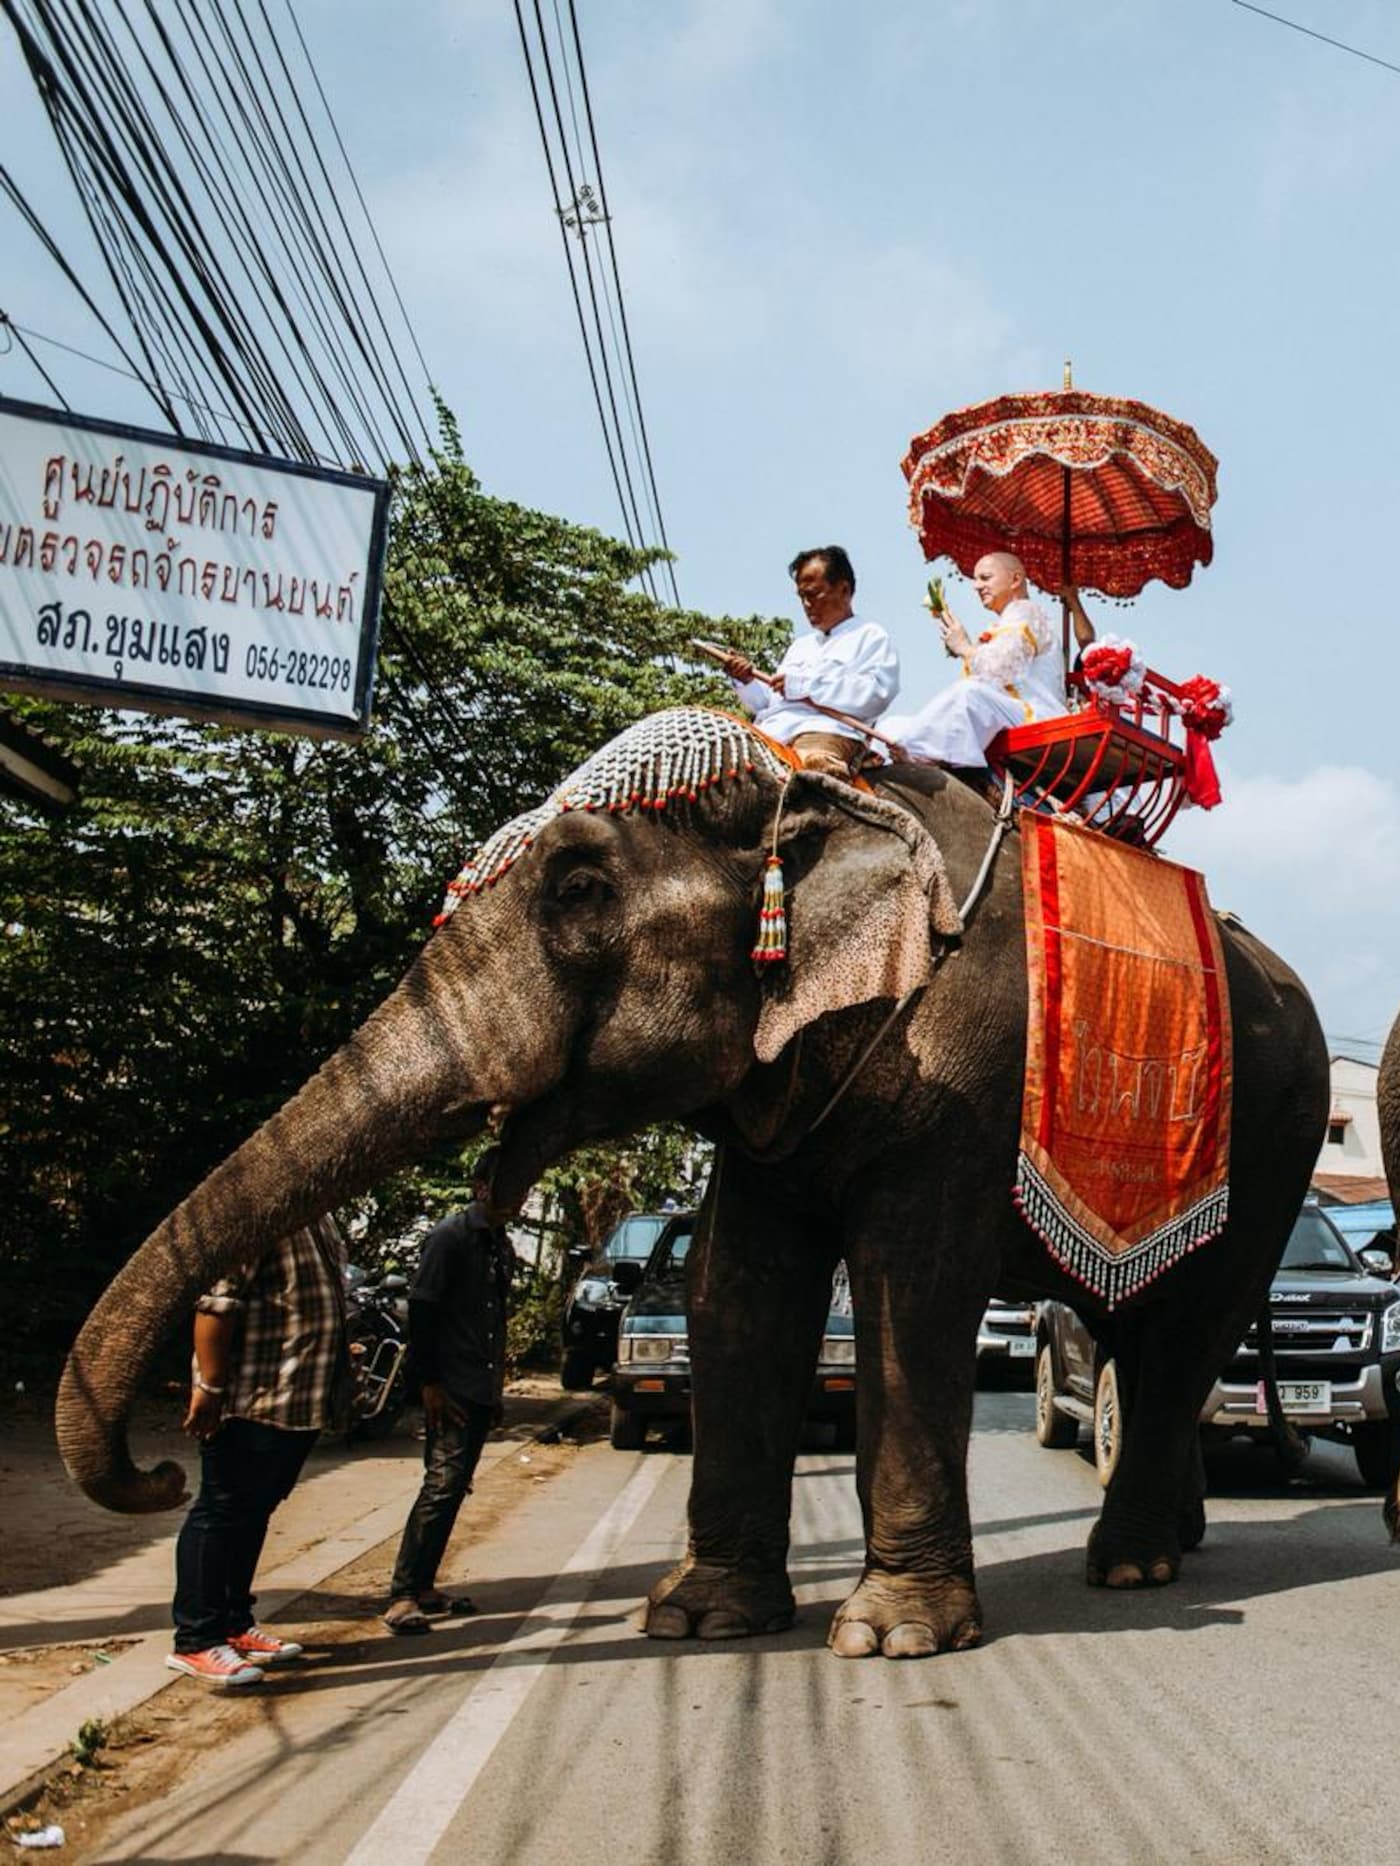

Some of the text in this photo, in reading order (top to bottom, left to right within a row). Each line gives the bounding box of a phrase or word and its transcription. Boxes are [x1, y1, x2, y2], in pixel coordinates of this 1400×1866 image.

[43, 454, 279, 541] ศูนย์ปฏิบัติการ
[37, 601, 352, 693] สภ.ชุมแสง 056-282298
[1294, 1385, 1319, 1400] 959
